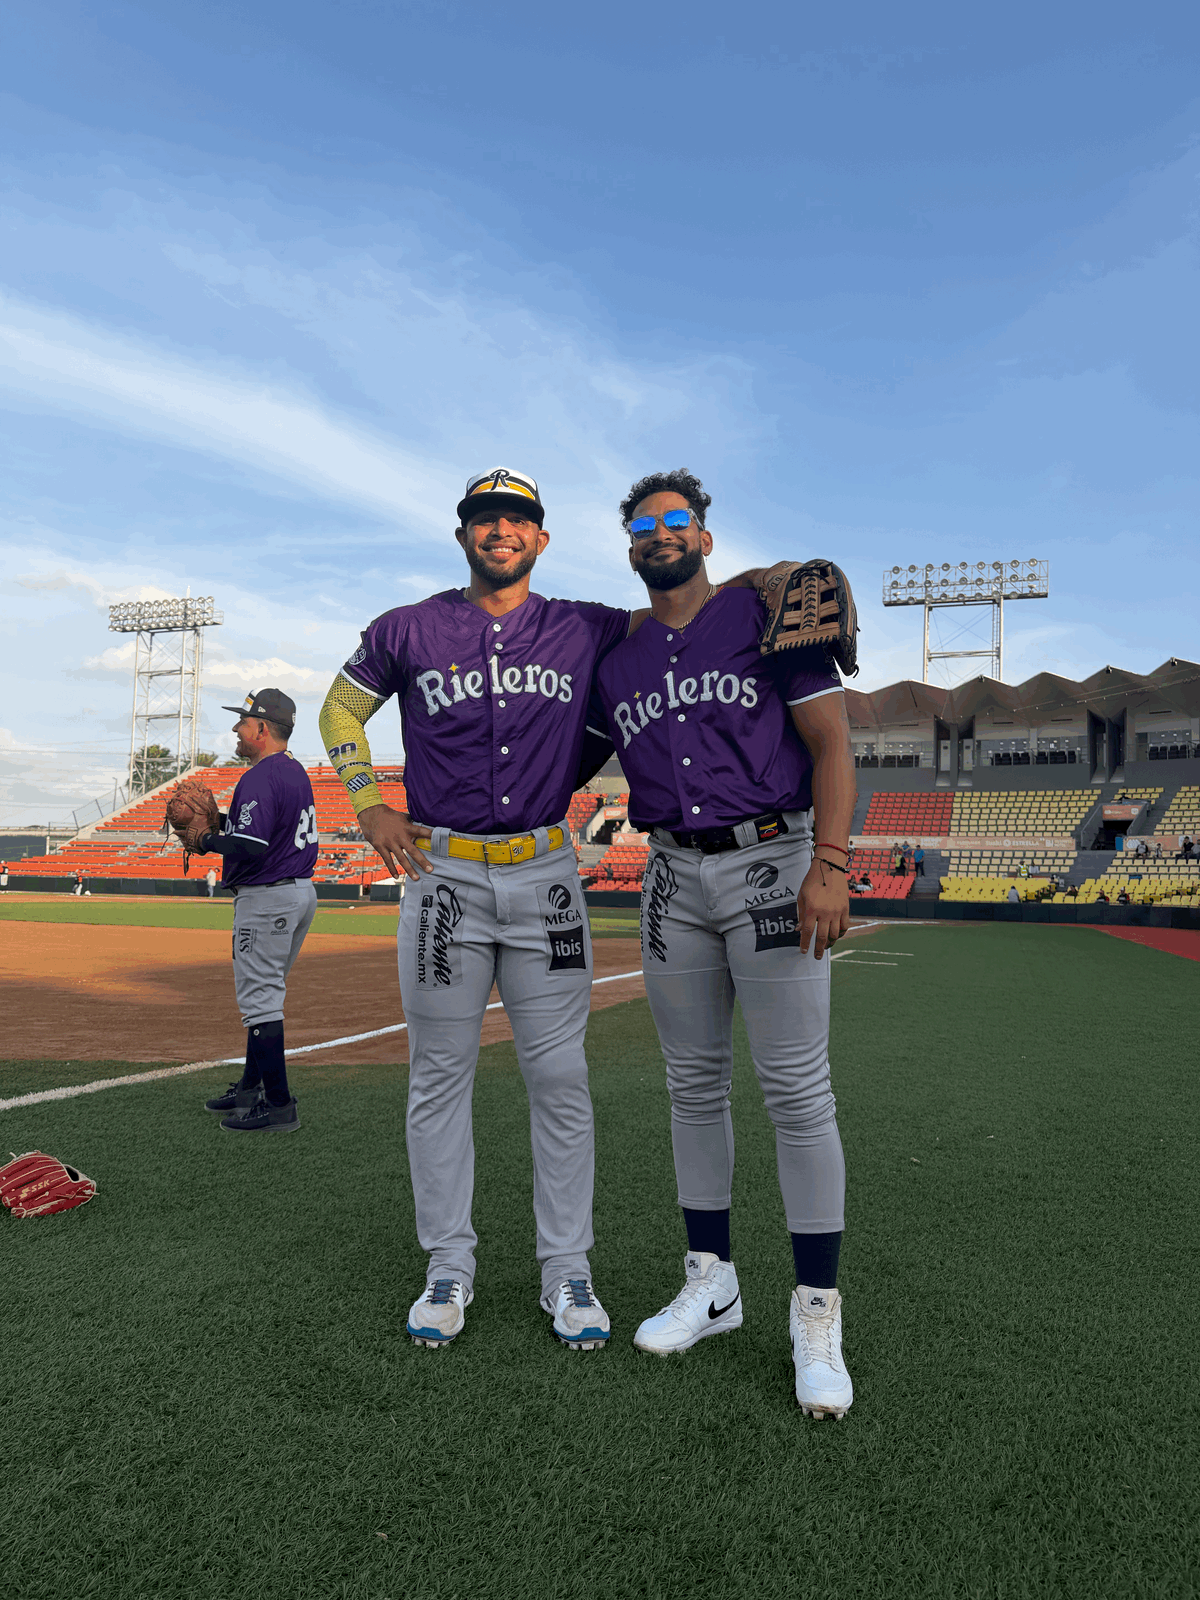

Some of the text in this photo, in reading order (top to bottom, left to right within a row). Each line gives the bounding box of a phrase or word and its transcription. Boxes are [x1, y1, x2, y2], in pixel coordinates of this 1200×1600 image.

[416, 654, 573, 717] Rieleros
[613, 670, 759, 750] Rieleros
[512, 845, 524, 857] 30
[744, 886, 795, 909] MEGA
[545, 909, 582, 927] MEGA
[759, 916, 796, 936] ibis
[418, 909, 430, 984] caliente.mx
[555, 939, 582, 957] ibis
